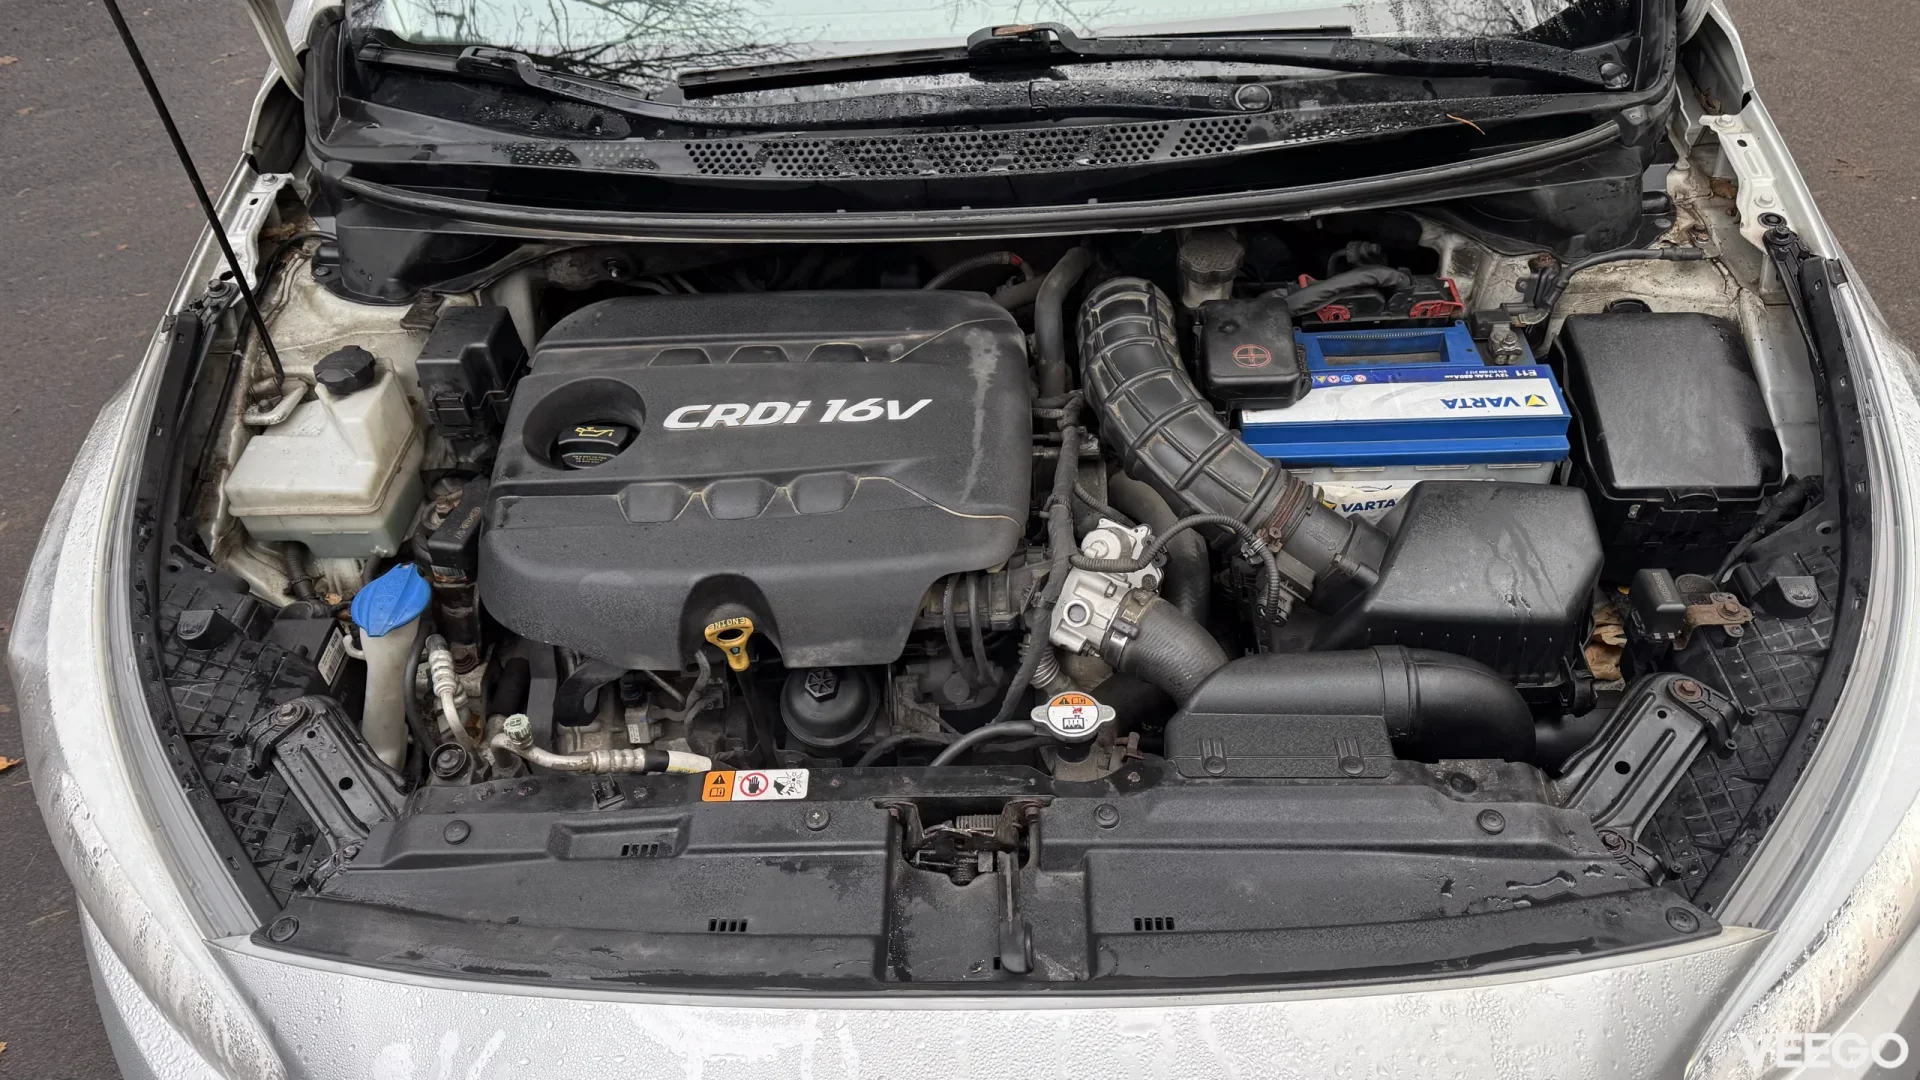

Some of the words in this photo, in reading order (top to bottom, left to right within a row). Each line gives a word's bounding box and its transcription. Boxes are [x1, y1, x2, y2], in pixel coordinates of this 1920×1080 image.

[1515, 369, 1538, 377] E11
[1440, 397, 1520, 409] VARTA
[663, 400, 811, 430] CRDi
[818, 397, 933, 423] 16V
[1341, 499, 1396, 512] VARTA
[708, 616, 746, 631] ENGINE
